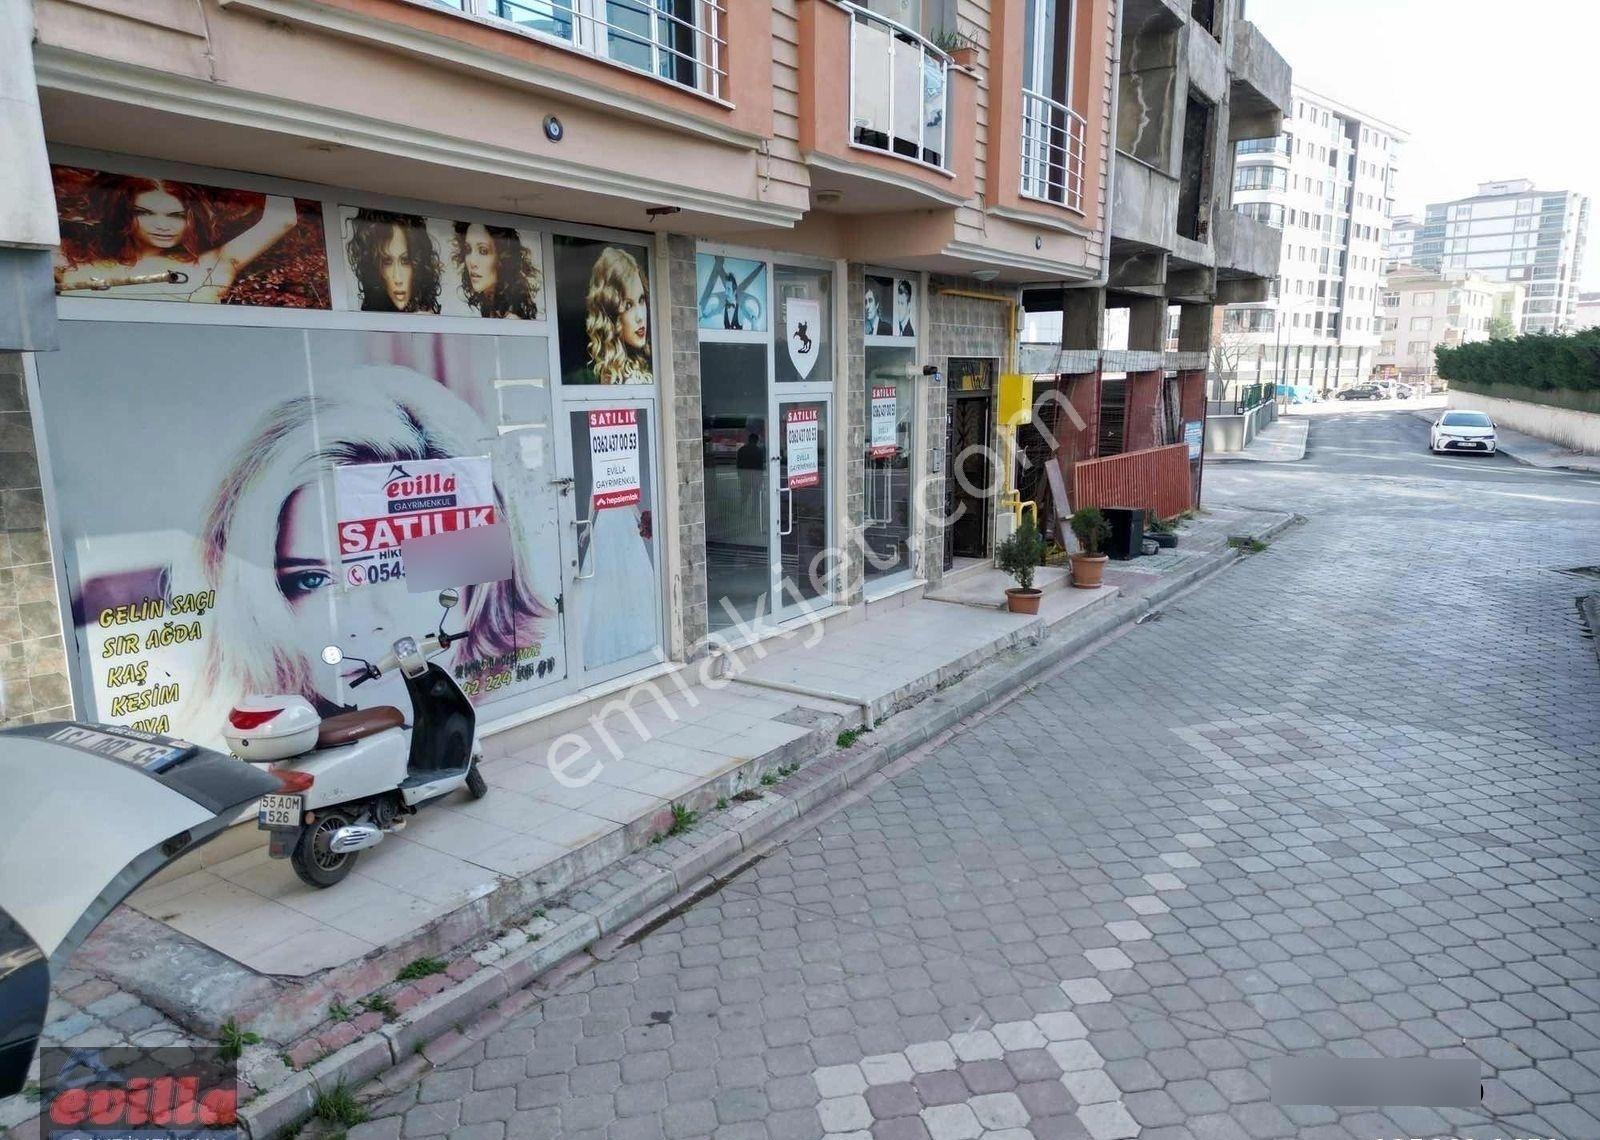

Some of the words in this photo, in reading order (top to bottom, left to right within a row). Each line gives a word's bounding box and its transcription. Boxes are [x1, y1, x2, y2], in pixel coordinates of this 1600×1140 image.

[872, 388, 896, 398] SATILIK
[590, 411, 636, 425] SATILIK
[788, 410, 817, 421] SATILIK
[593, 436, 608, 453] 0362
[620, 433, 628, 450] 00
[629, 432, 636, 450] 53
[387, 474, 456, 498] evilla
[394, 498, 451, 511] GAYRİMENKUL
[98, 597, 165, 628] GELİN
[170, 590, 216, 616] SAÇI
[102, 634, 140, 658] SIR
[146, 622, 202, 650] AĞDA
[107, 660, 149, 687] KAŞ
[485, 670, 511, 692] 224
[111, 683, 180, 718] KESİM
[262, 796, 276, 808] 55
[278, 797, 300, 810] AOM
[268, 810, 289, 824] 526
